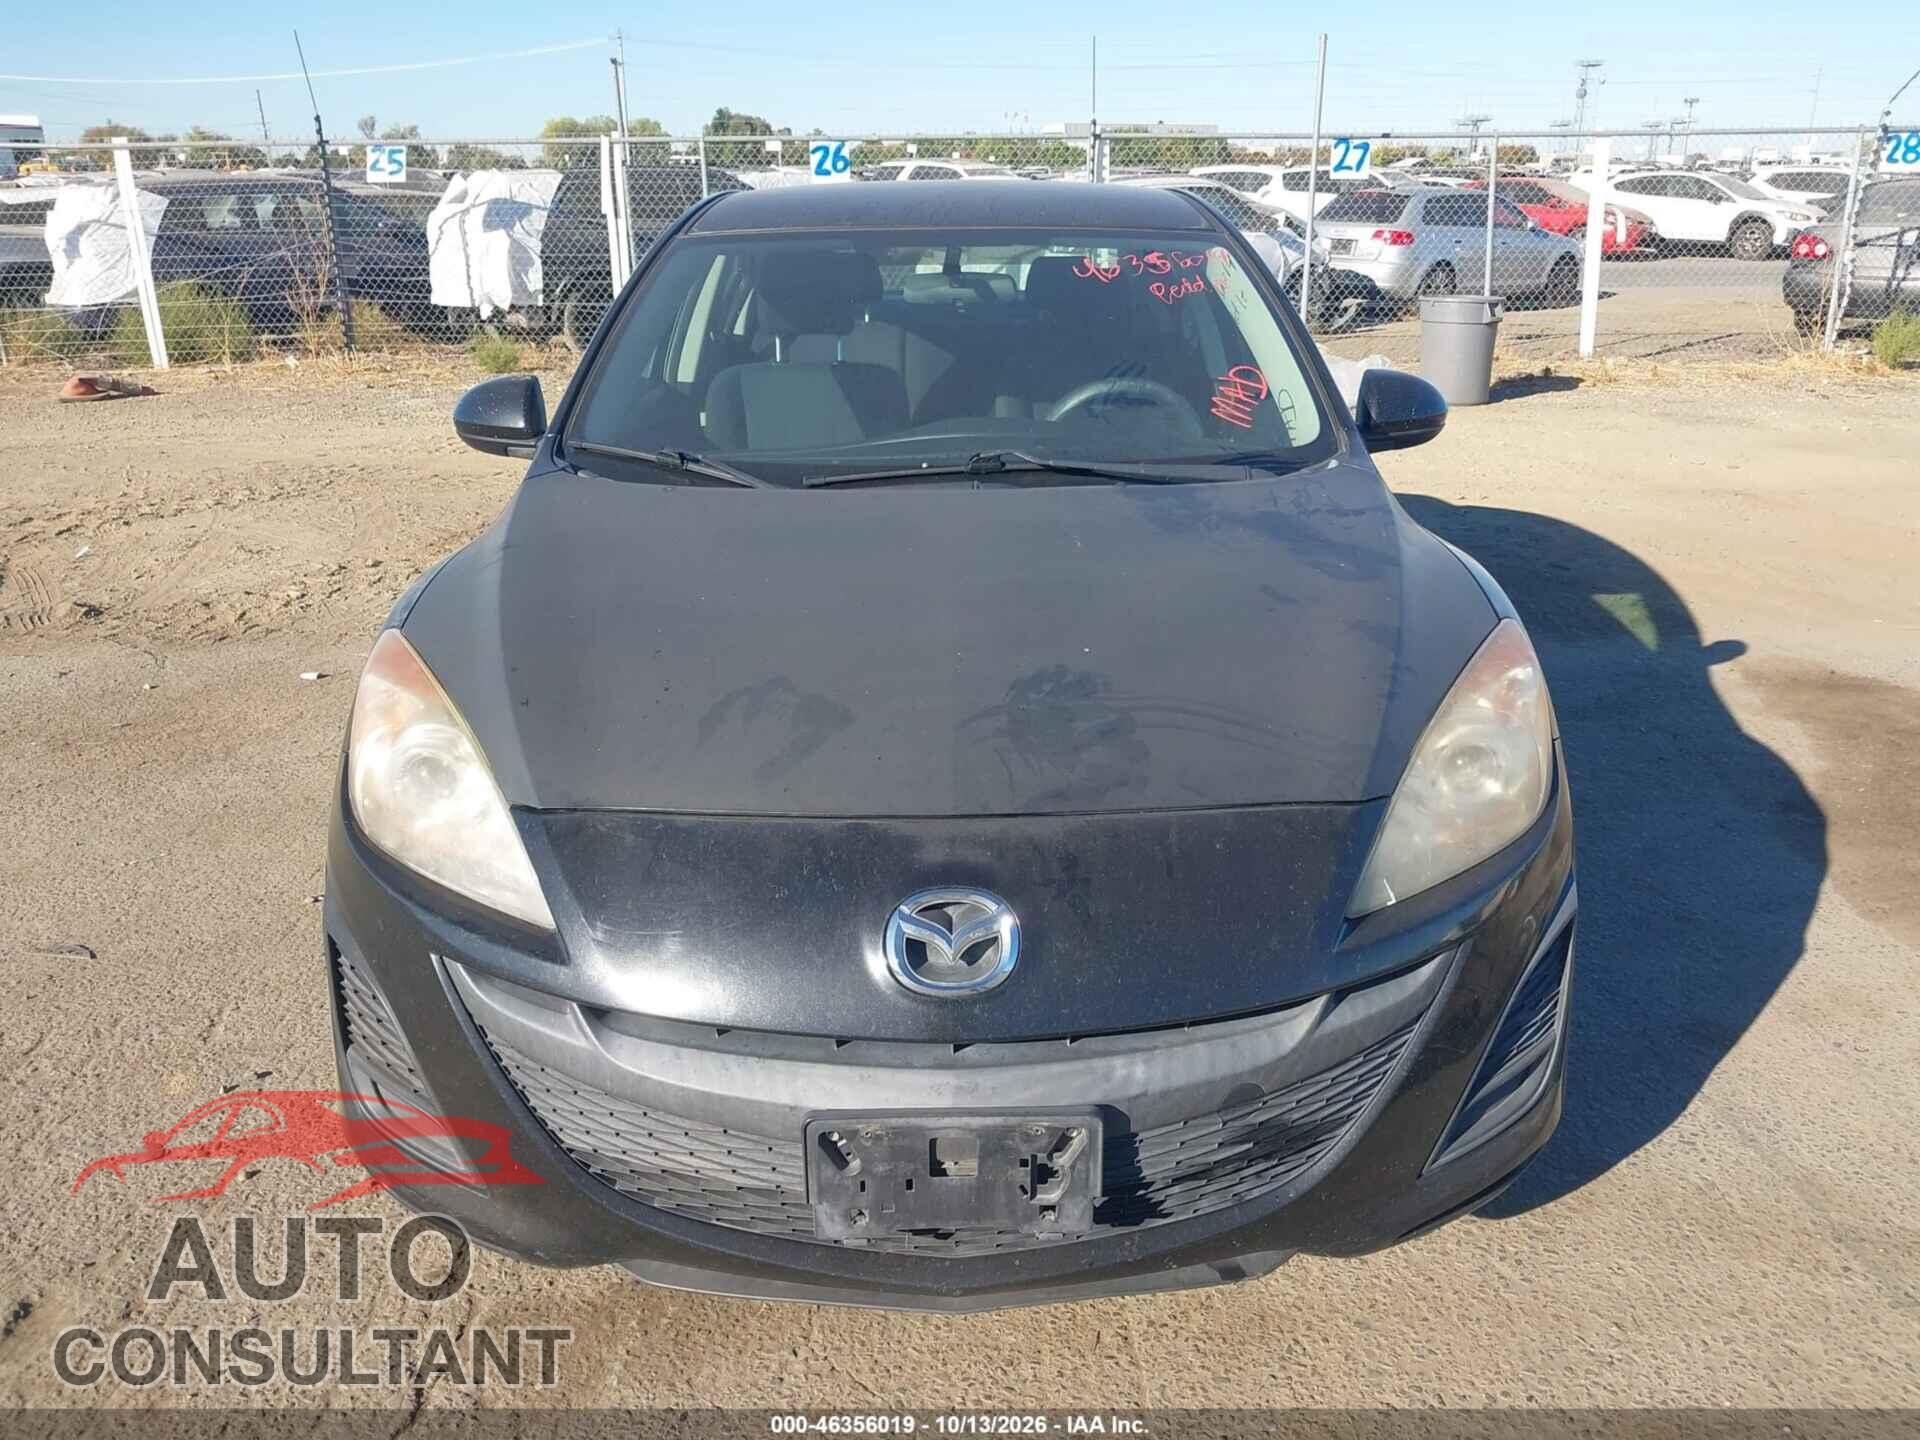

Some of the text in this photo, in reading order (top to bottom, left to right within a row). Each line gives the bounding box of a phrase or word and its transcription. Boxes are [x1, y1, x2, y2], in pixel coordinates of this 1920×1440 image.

[369, 145, 404, 176] 25
[810, 140, 850, 176] 26
[1333, 137, 1370, 172] 27
[1886, 131, 1920, 164] 28
